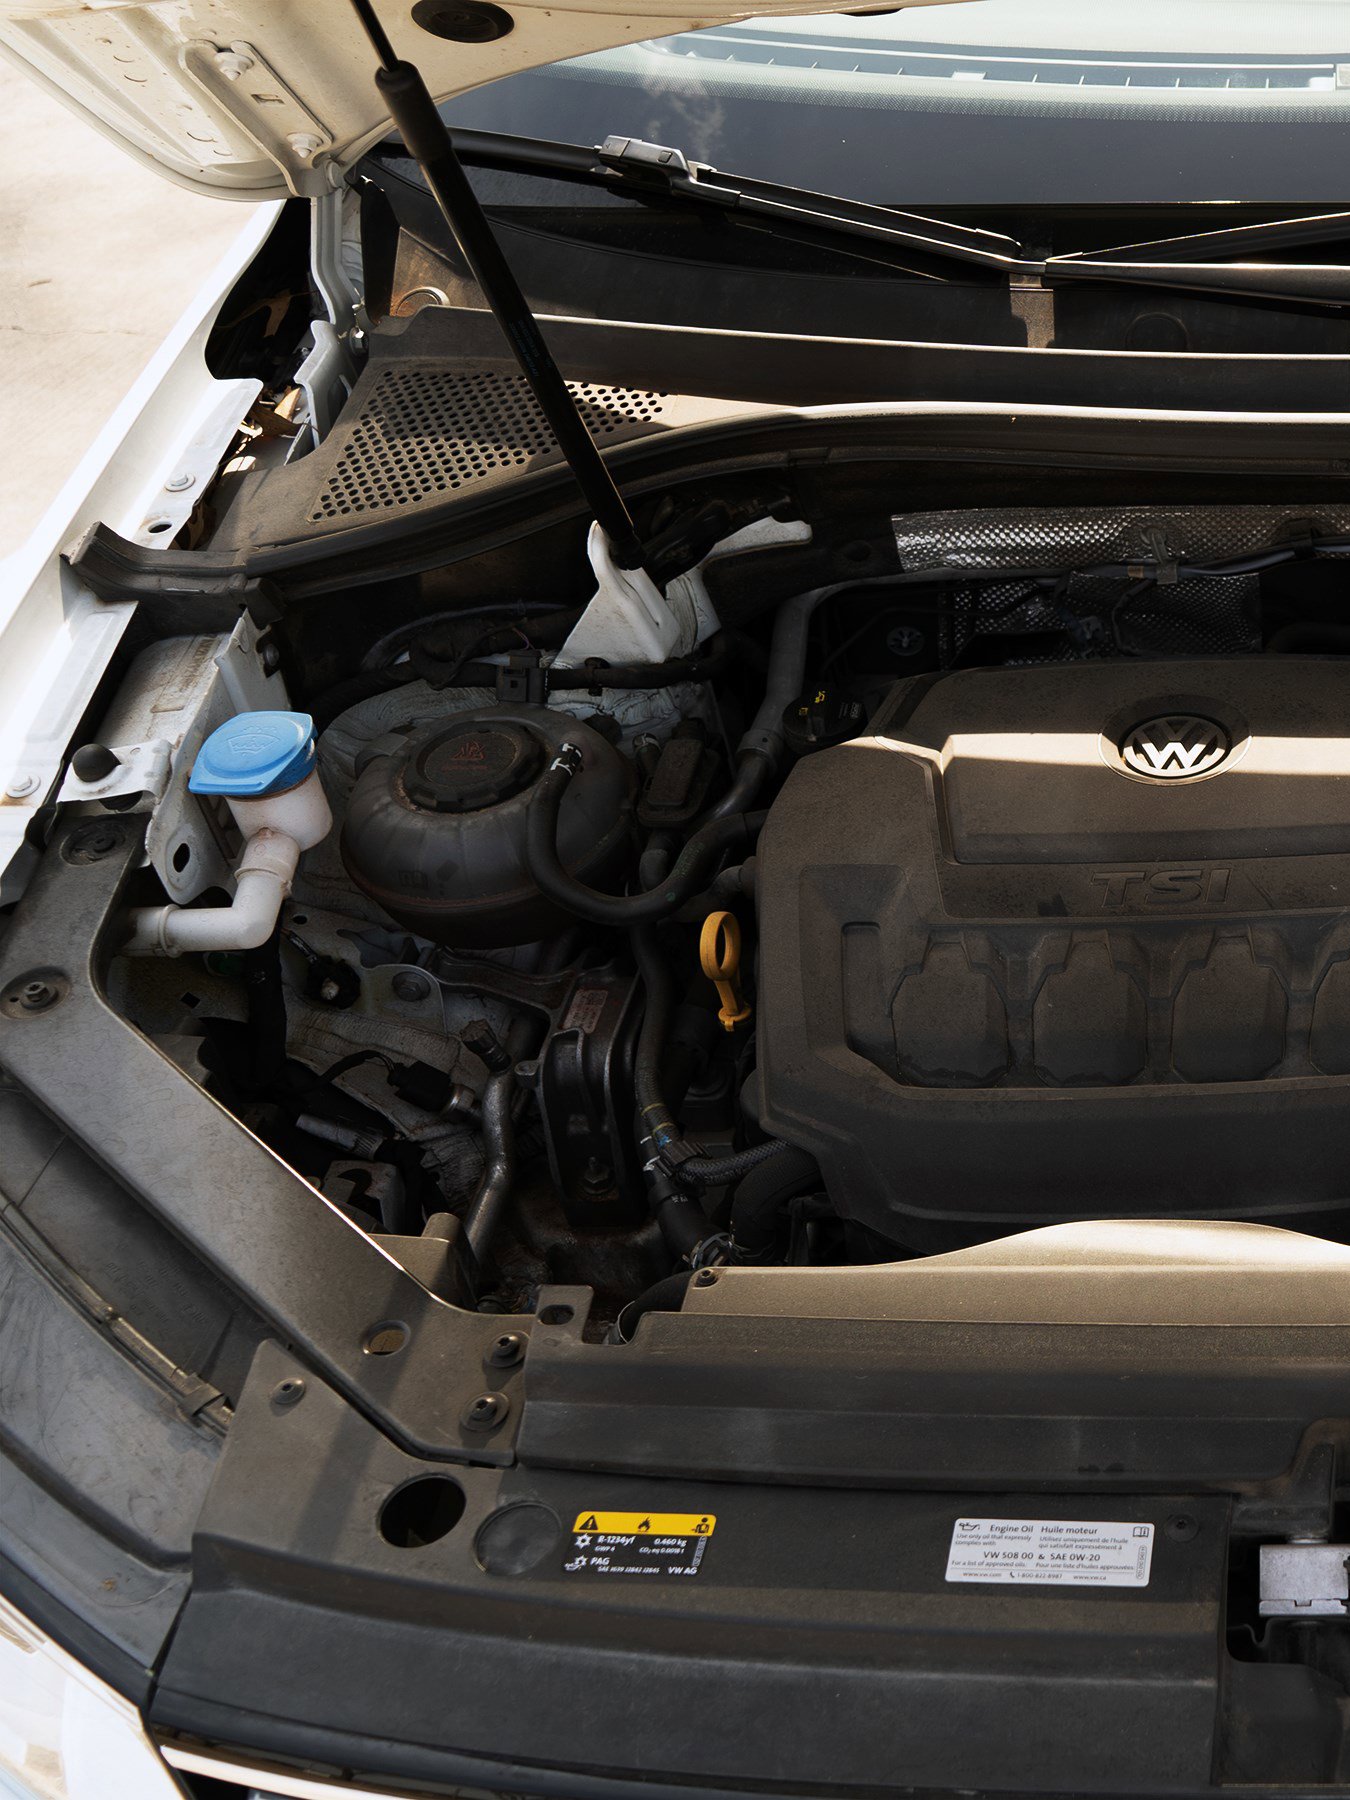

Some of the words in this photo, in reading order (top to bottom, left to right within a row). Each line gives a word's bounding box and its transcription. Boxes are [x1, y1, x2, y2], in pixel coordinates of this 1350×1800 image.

[1090, 866, 1231, 908] TSI
[989, 1524, 1019, 1533] Engine
[598, 1535, 636, 1545] R-1234yf
[676, 1538, 687, 1547] kg
